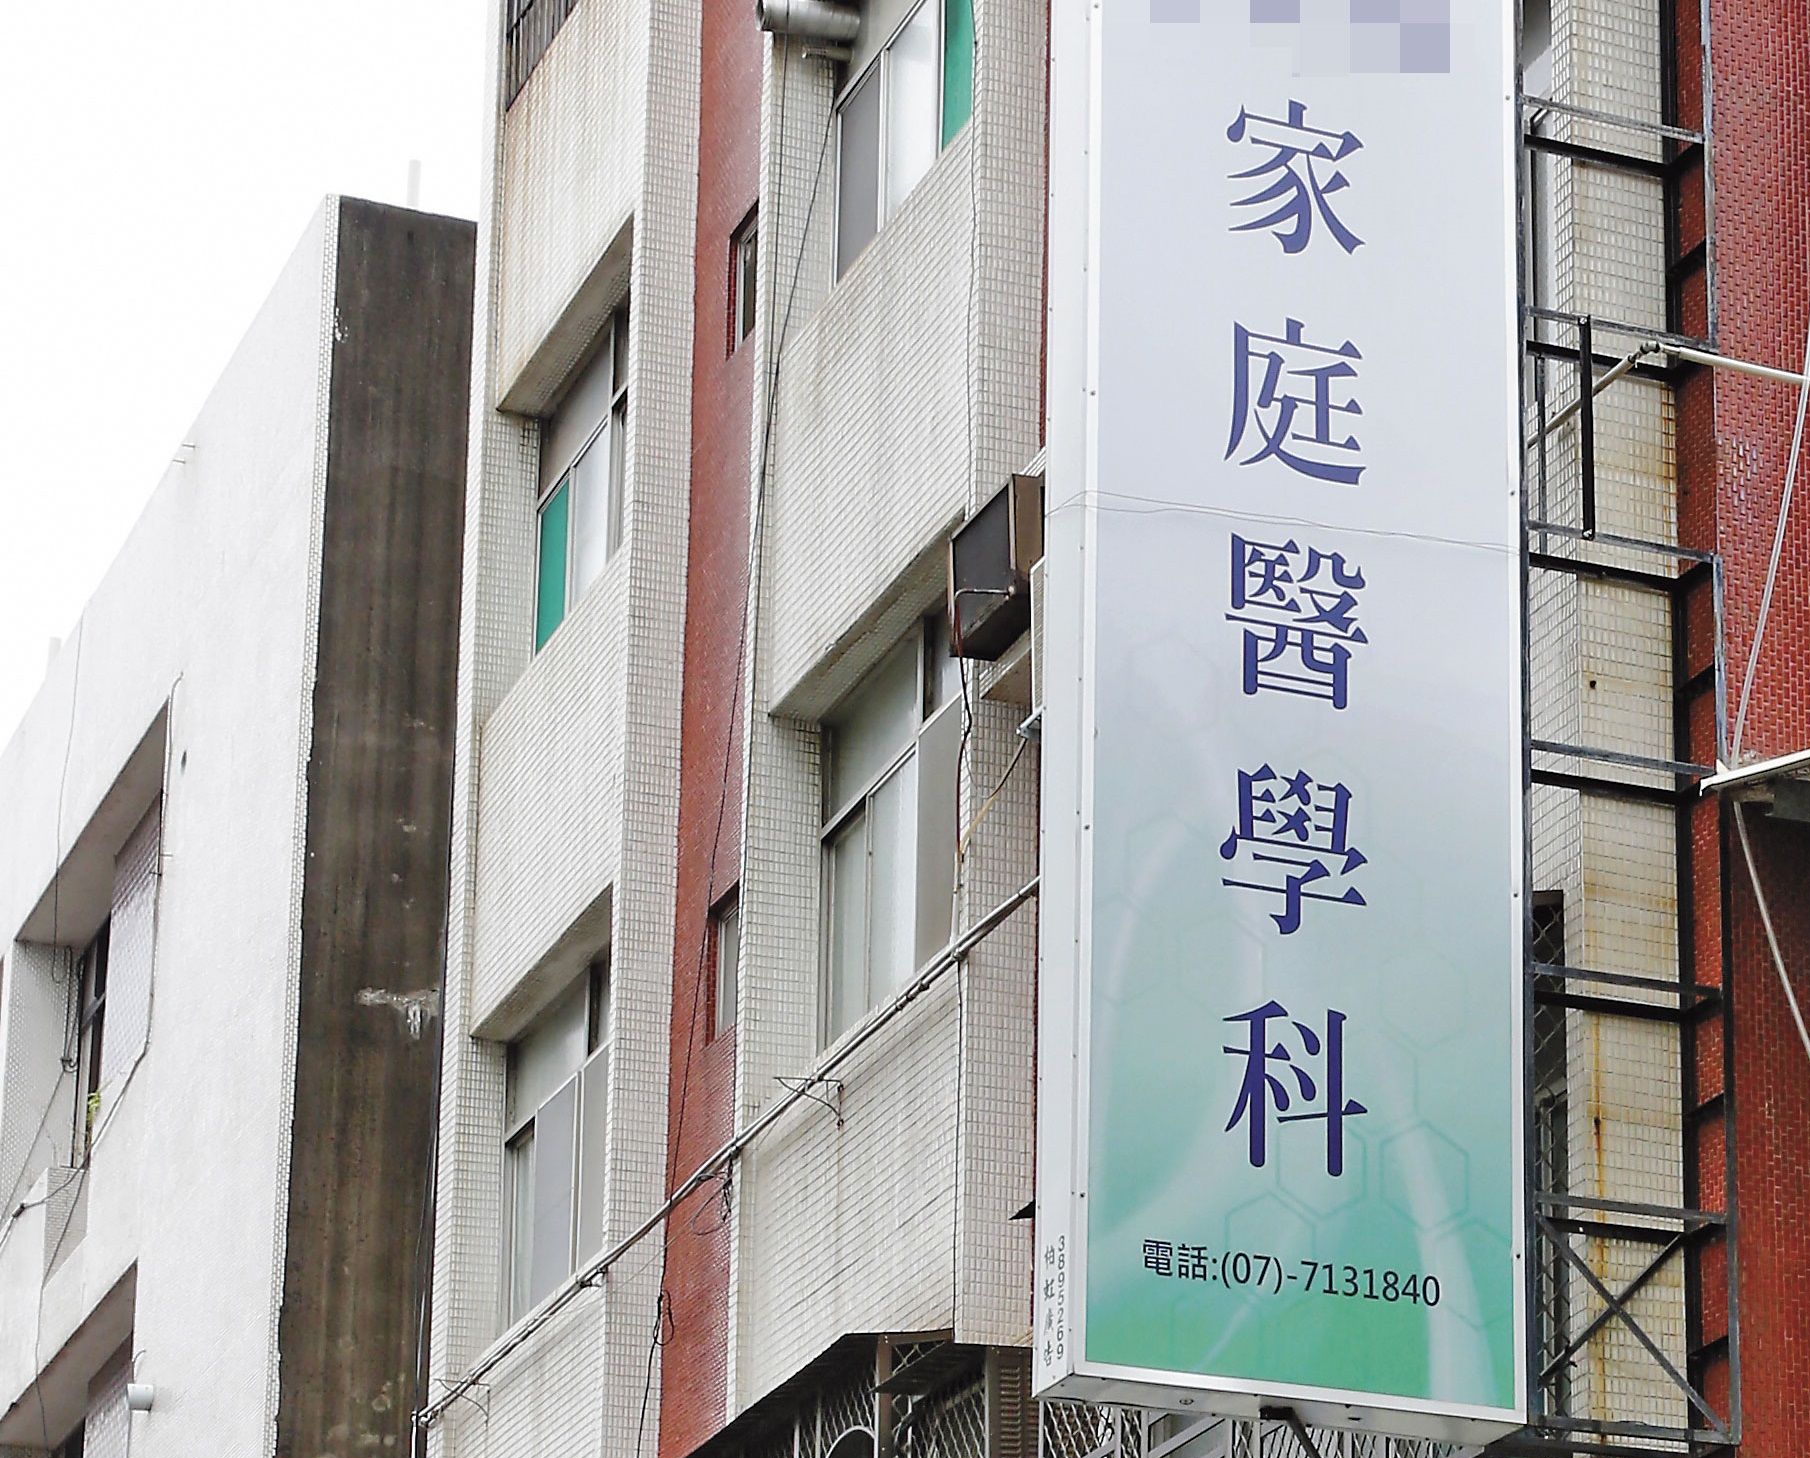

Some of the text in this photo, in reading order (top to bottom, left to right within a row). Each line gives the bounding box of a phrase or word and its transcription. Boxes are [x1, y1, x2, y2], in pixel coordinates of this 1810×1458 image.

[1221, 99, 1368, 1178] 家庭醫學科
[1057, 1235, 1066, 1360] 3895269
[1142, 1239, 1441, 1307] 電話:(07)-7131840
